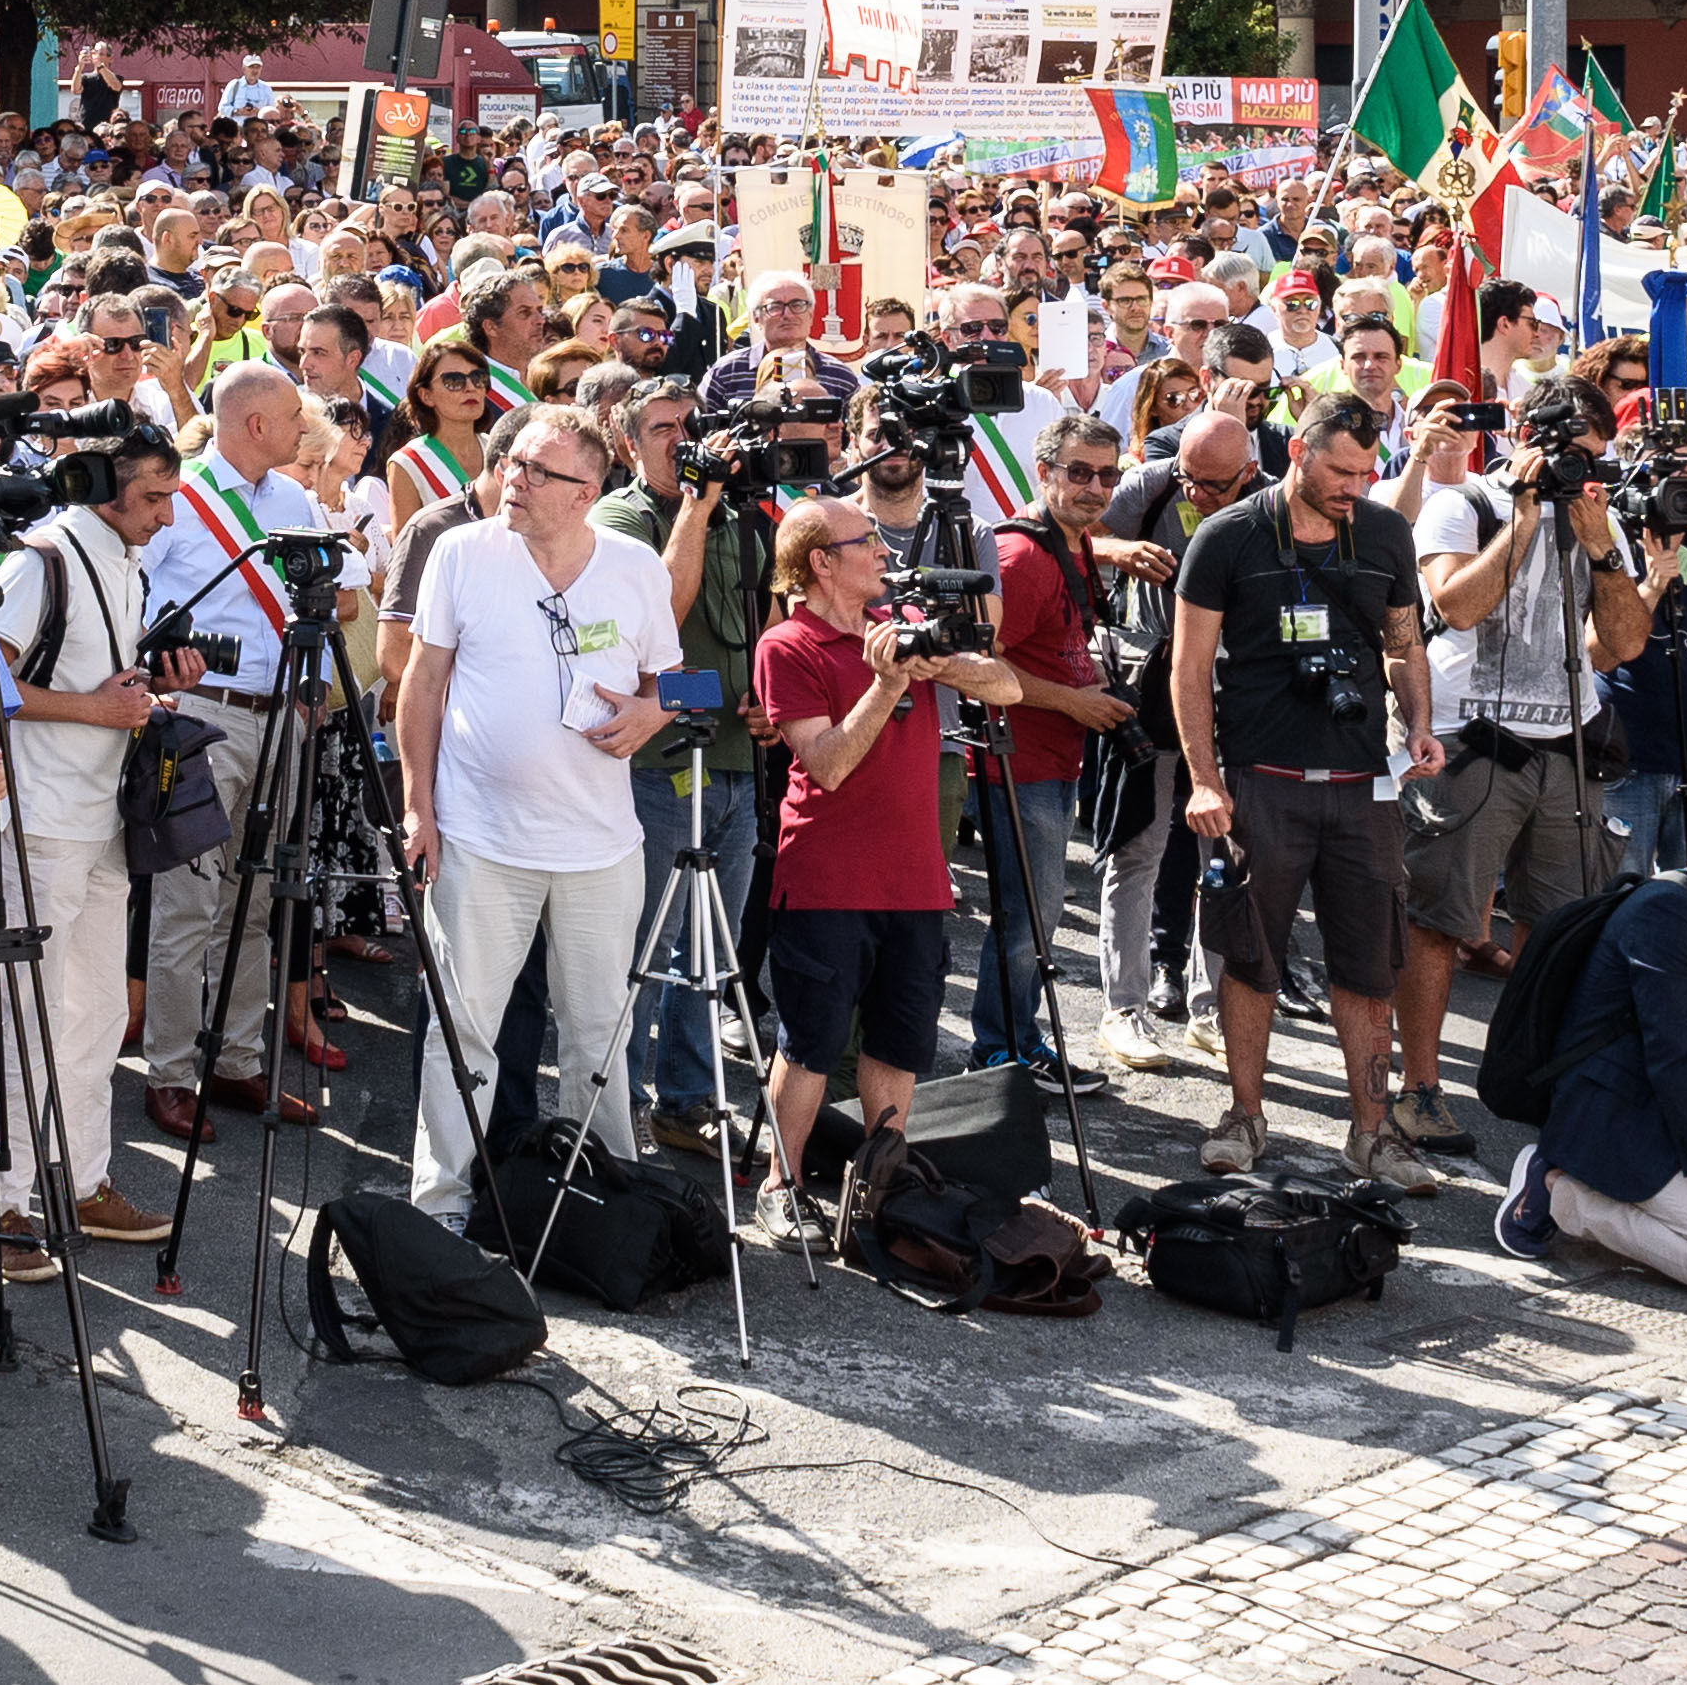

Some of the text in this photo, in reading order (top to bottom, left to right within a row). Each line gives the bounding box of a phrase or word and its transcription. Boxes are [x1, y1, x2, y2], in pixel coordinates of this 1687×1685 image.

[732, 81, 744, 90] La
[746, 81, 774, 91] classe
[776, 83, 820, 93] dominan
[822, 85, 845, 95] punta
[951, 87, 969, 95] della
[971, 88, 1004, 96] memoria,
[1019, 88, 1042, 97] sappia
[1044, 88, 1069, 97] questa
[1192, 78, 1222, 101] PIÙ
[1240, 79, 1315, 105] MAI PIÙ
[732, 93, 761, 102] classe
[763, 94, 778, 102] che
[781, 94, 800, 103] nella
[844, 96, 878, 105] popolare
[880, 97, 913, 105] nessuno
[945, 98, 969, 106] crimini
[738, 105, 783, 114] consumati
[786, 105, 798, 114] nel
[841, 107, 860, 115] della
[877, 108, 909, 116] dittatura
[1170, 102, 1223, 118] ASCISMI
[1241, 105, 1313, 121] RAZZISMI
[822, 118, 841, 127] otrà
[748, 193, 916, 230] COMUNE BERTINORO
[1463, 698, 1572, 726] MANHATT
[161, 758, 173, 792] Nikon
